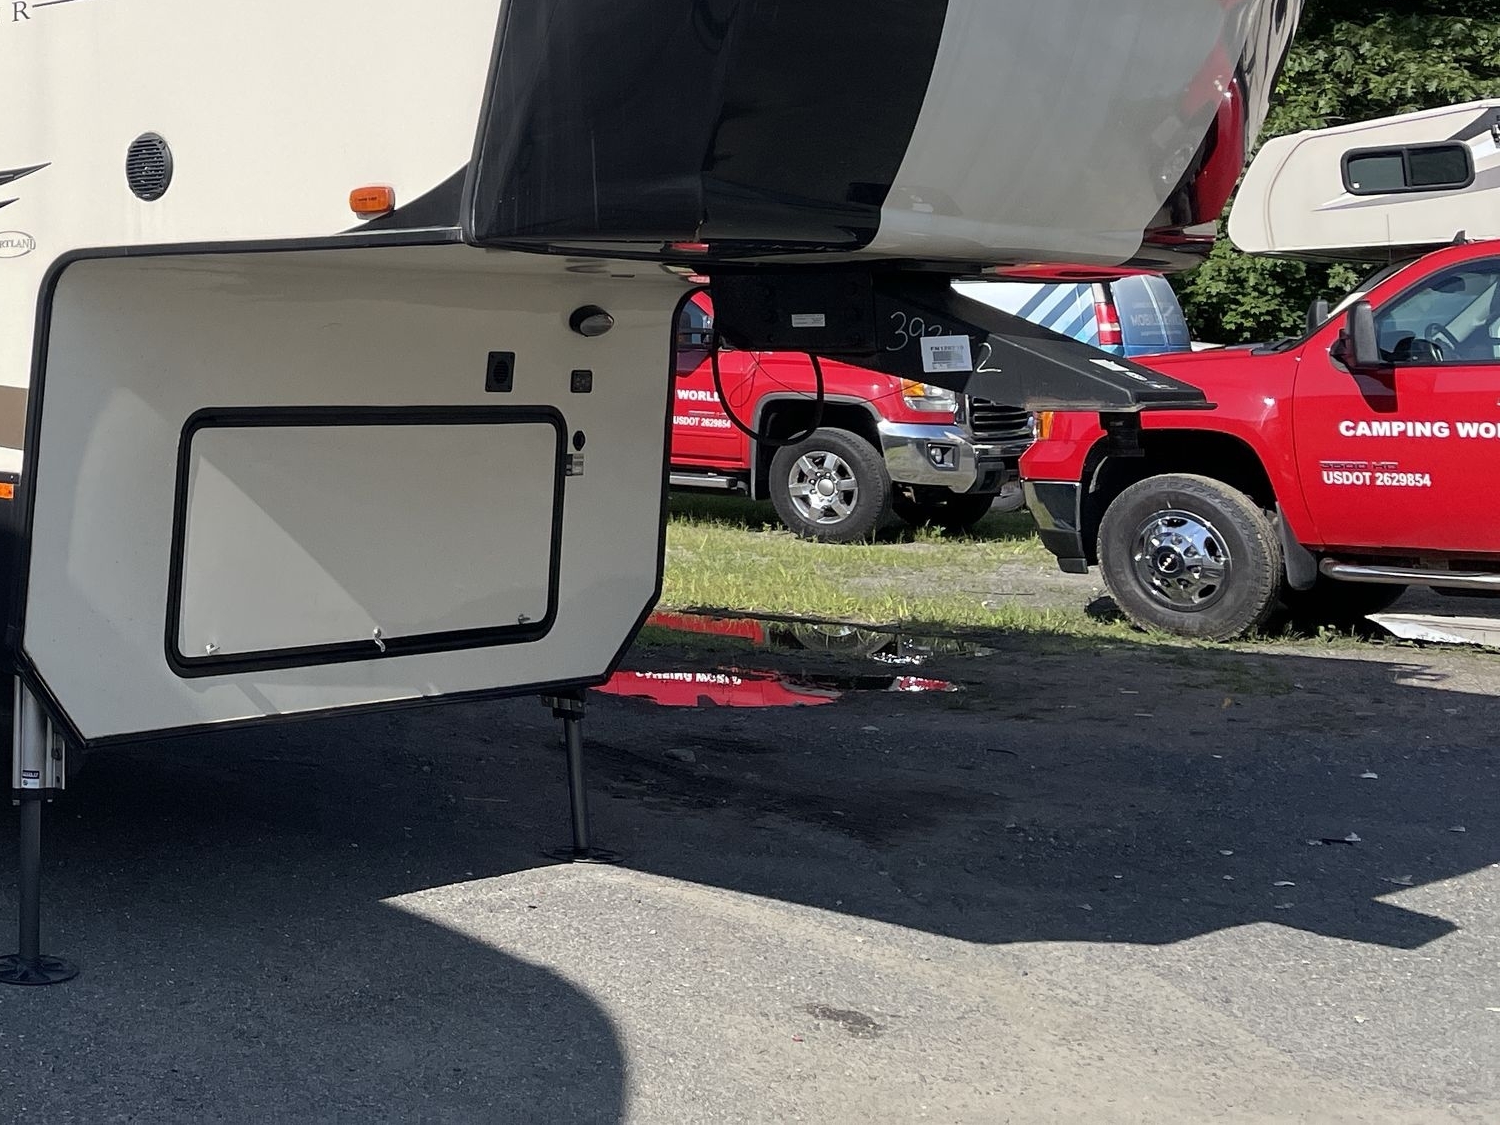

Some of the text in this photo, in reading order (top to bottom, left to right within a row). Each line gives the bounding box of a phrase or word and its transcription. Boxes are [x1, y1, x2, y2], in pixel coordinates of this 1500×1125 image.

[673, 416, 700, 426] USDOT
[1339, 420, 1500, 439] CAMPING WO
[1322, 471, 1431, 488] USDOT 2629854
